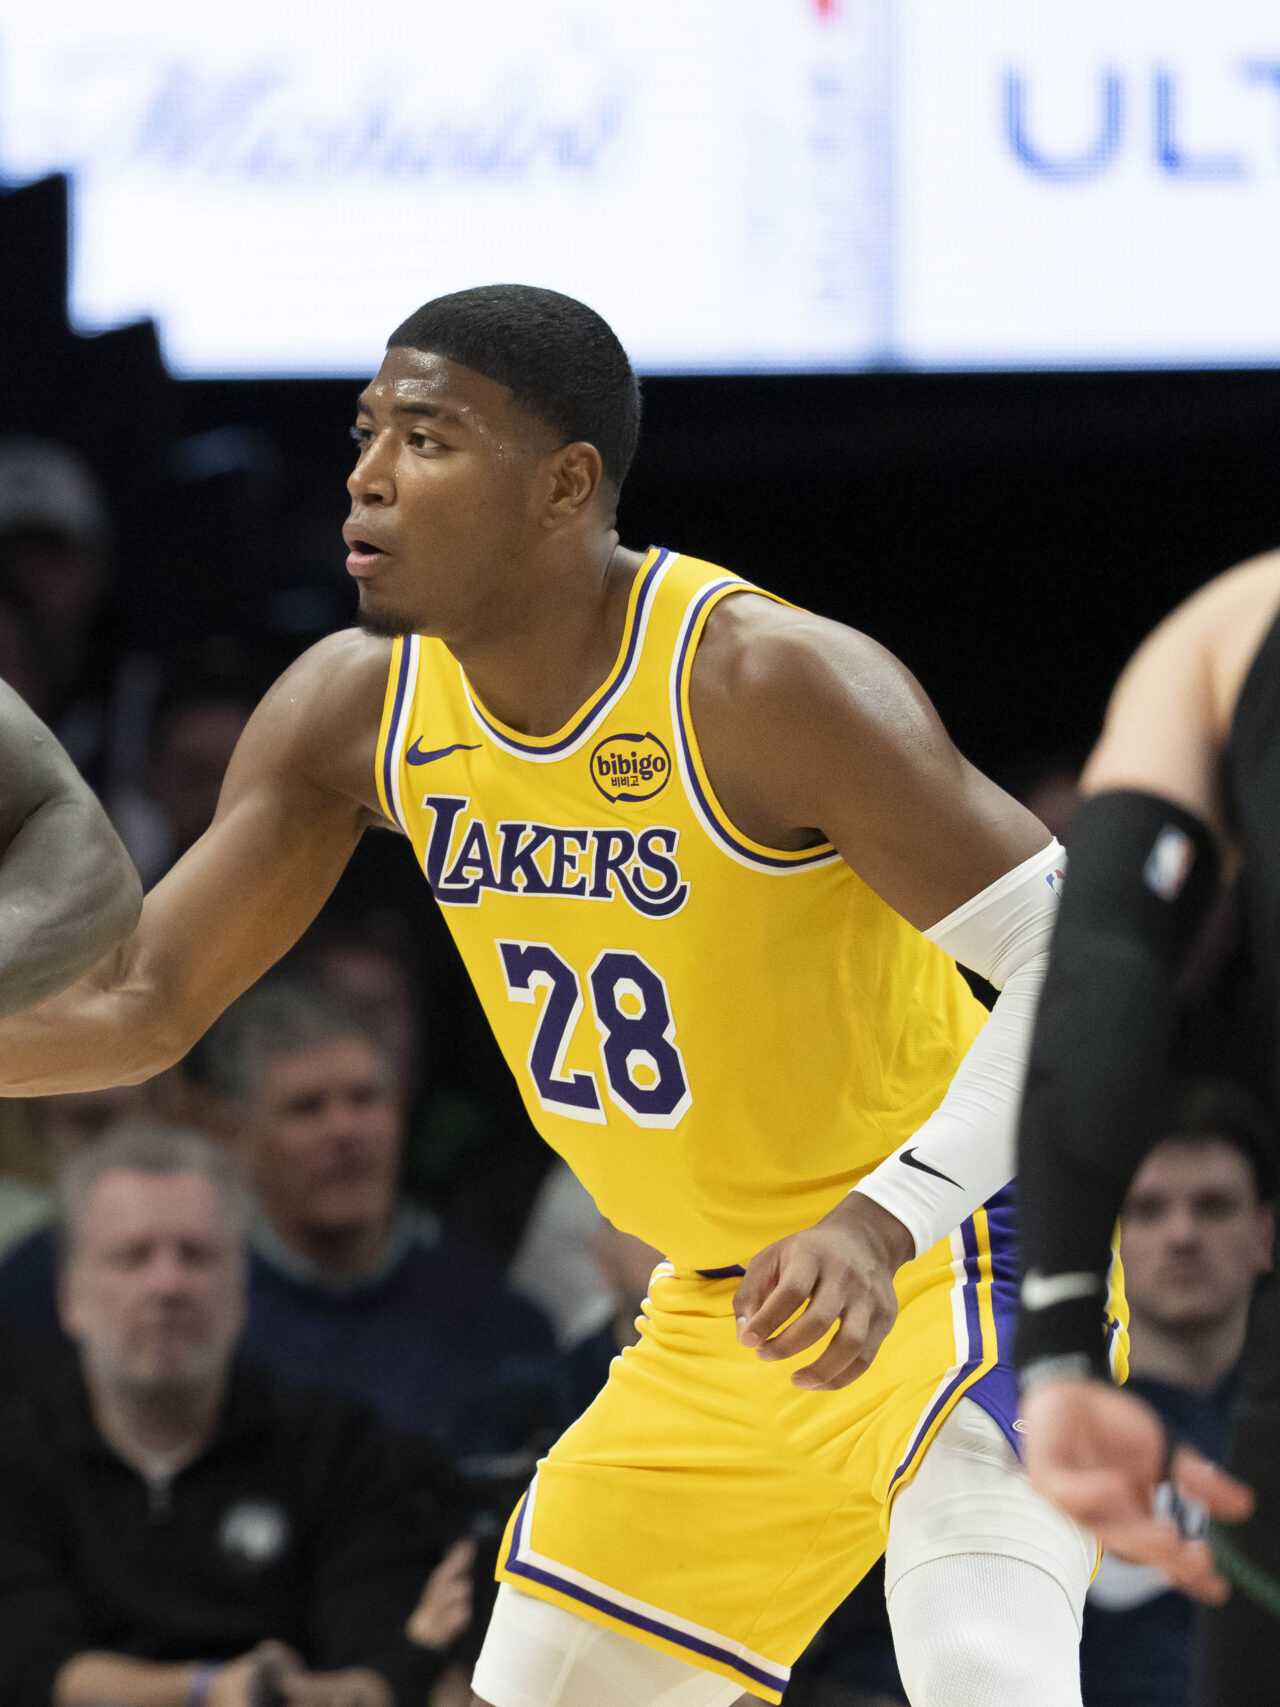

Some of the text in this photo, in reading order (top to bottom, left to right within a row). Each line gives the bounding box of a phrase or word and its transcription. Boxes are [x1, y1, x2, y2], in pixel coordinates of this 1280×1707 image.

[596, 751, 666, 781] bibigo
[610, 775, 640, 788] 비비고
[422, 793, 692, 920] LAKERS
[494, 938, 693, 1130] 28
